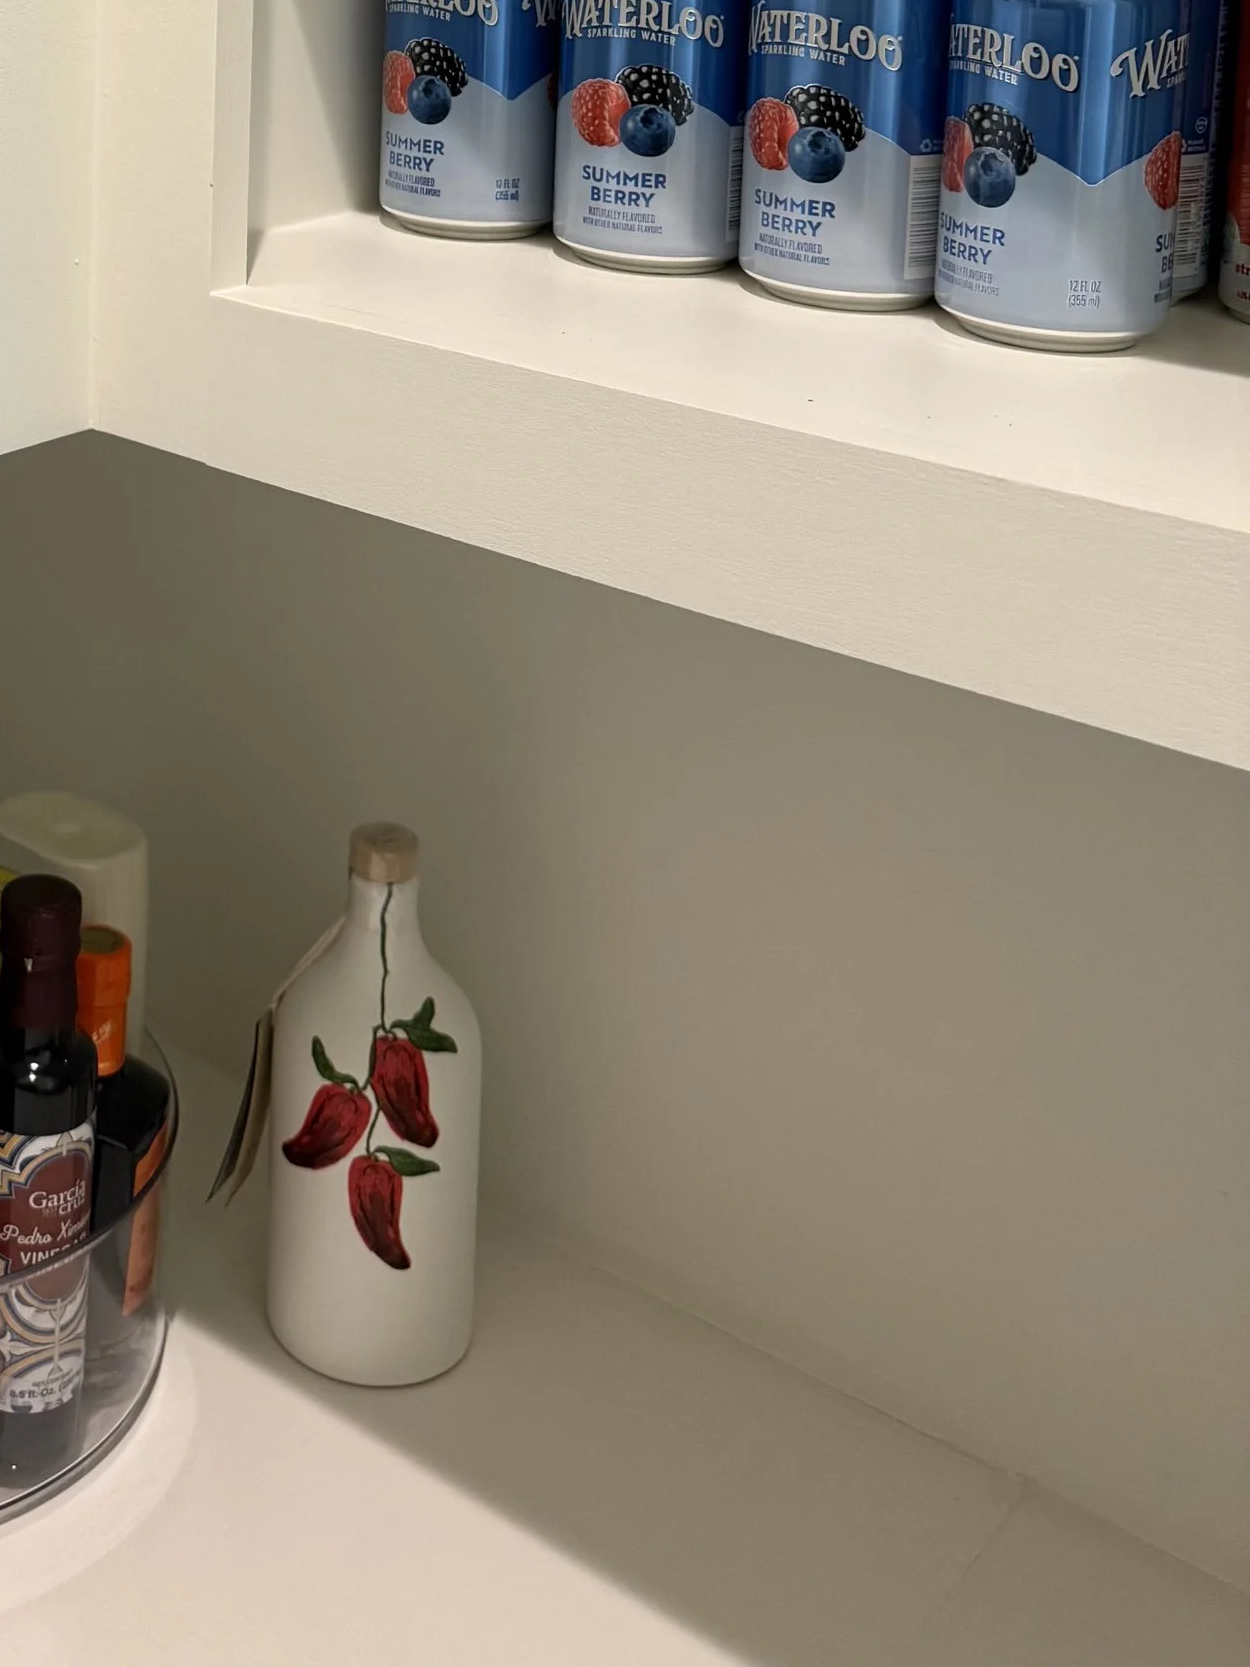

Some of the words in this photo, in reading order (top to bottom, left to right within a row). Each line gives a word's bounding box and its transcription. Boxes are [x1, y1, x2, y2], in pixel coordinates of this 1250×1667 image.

[423, 5, 451, 22] WATER
[587, 28, 636, 39] SPARKLING
[641, 31, 676, 46] WATER
[761, 43, 805, 58] SPARKLING
[809, 49, 845, 66] WATER
[948, 23, 1079, 92] ATERLOO
[1110, 29, 1190, 99] WAT
[984, 65, 1018, 85] WATER
[385, 131, 444, 155] SUMMER
[390, 151, 434, 172] BERRY
[582, 165, 667, 189] SUMMER
[590, 186, 655, 207] BERRY
[754, 189, 836, 219] SUMMER
[588, 205, 621, 221] NATURALLY
[622, 211, 655, 223] FLAVORED
[761, 211, 822, 237] BERRY
[940, 212, 1005, 246] SUMMER
[759, 233, 788, 249] NATURALLY
[789, 240, 822, 254] FLAVORED
[943, 236, 992, 265] BERRY
[1069, 280, 1079, 292] 12
[1080, 281, 1089, 292] FL
[1091, 281, 1101, 293] OZ
[1068, 295, 1086, 308] (355
[1087, 296, 1100, 309] ml)
[29, 1179, 86, 1208] García
[0, 1224, 52, 1244] Pedro
